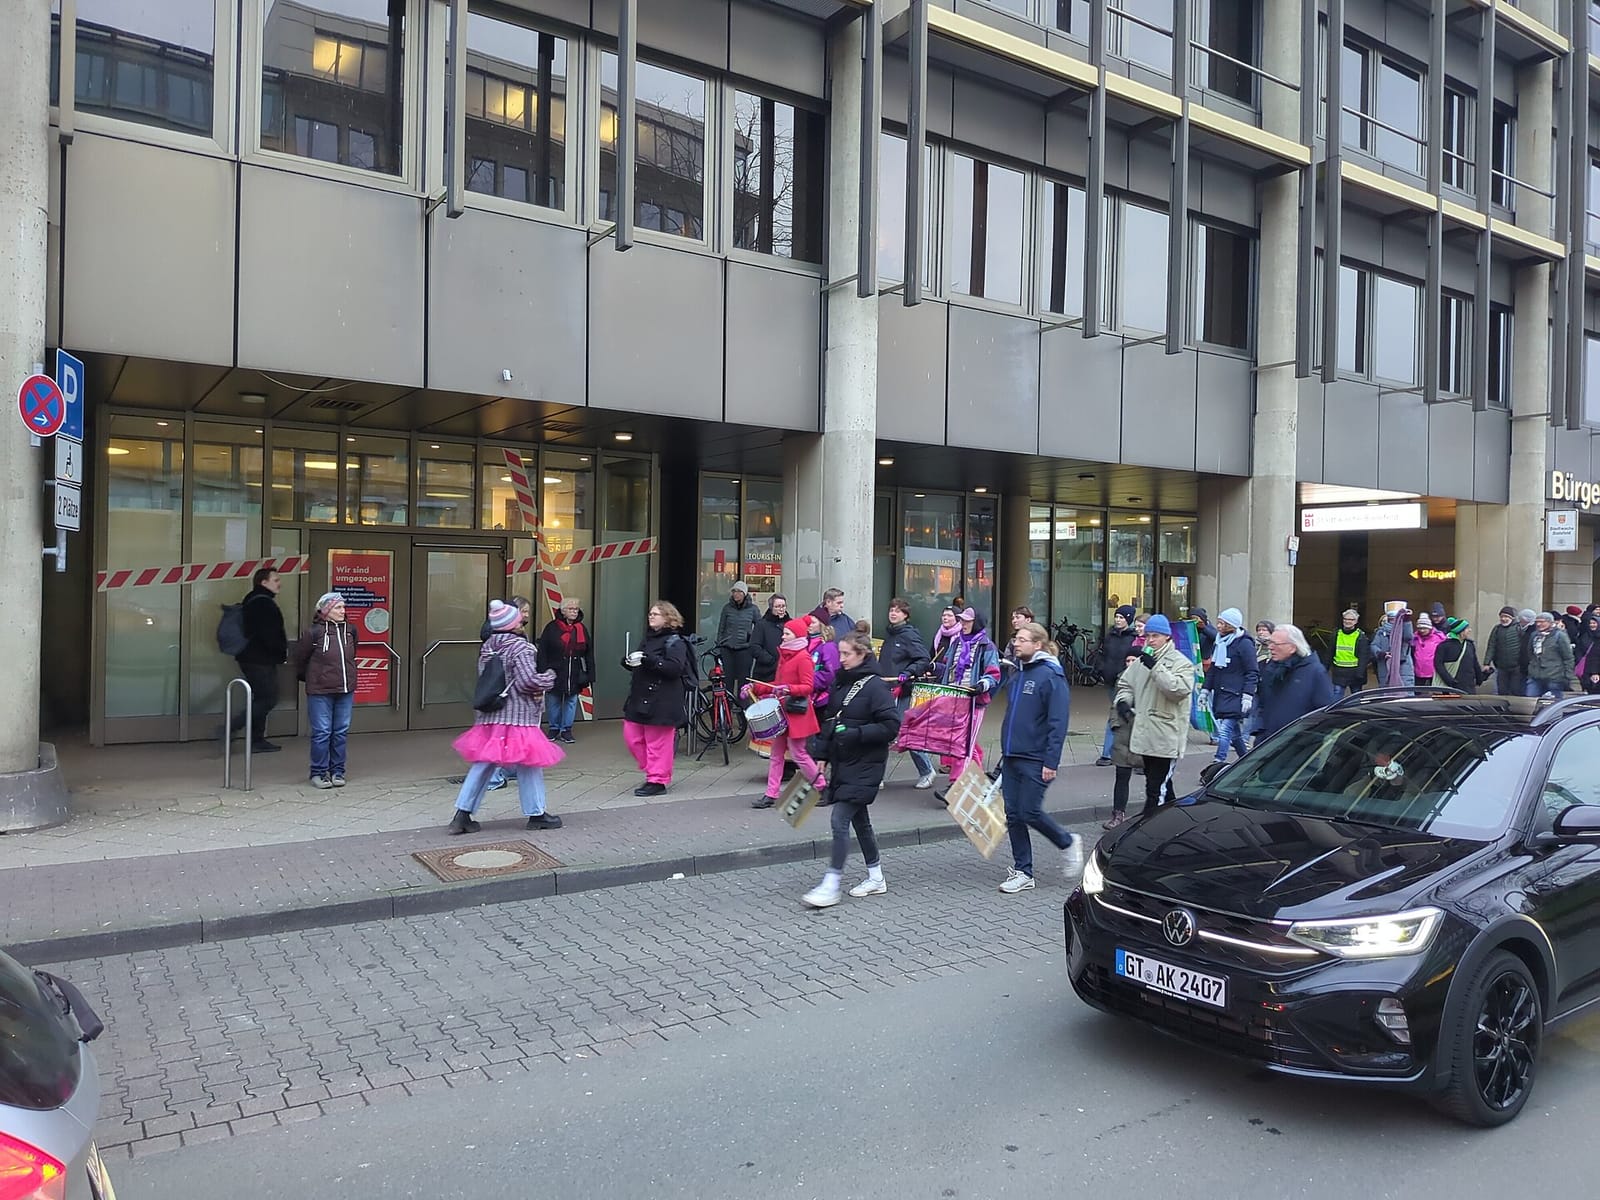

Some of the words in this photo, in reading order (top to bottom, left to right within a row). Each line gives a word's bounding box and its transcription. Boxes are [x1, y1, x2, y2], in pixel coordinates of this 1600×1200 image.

[63, 363, 78, 424] P
[58, 495, 62, 515] 2
[62, 496, 79, 518] Plätze
[335, 565, 351, 573] Wir
[352, 565, 370, 574] sind
[335, 575, 386, 584] umgezogen!
[1125, 955, 1145, 979] GT
[1156, 964, 1176, 990] AK
[1179, 971, 1223, 1002] 2407
